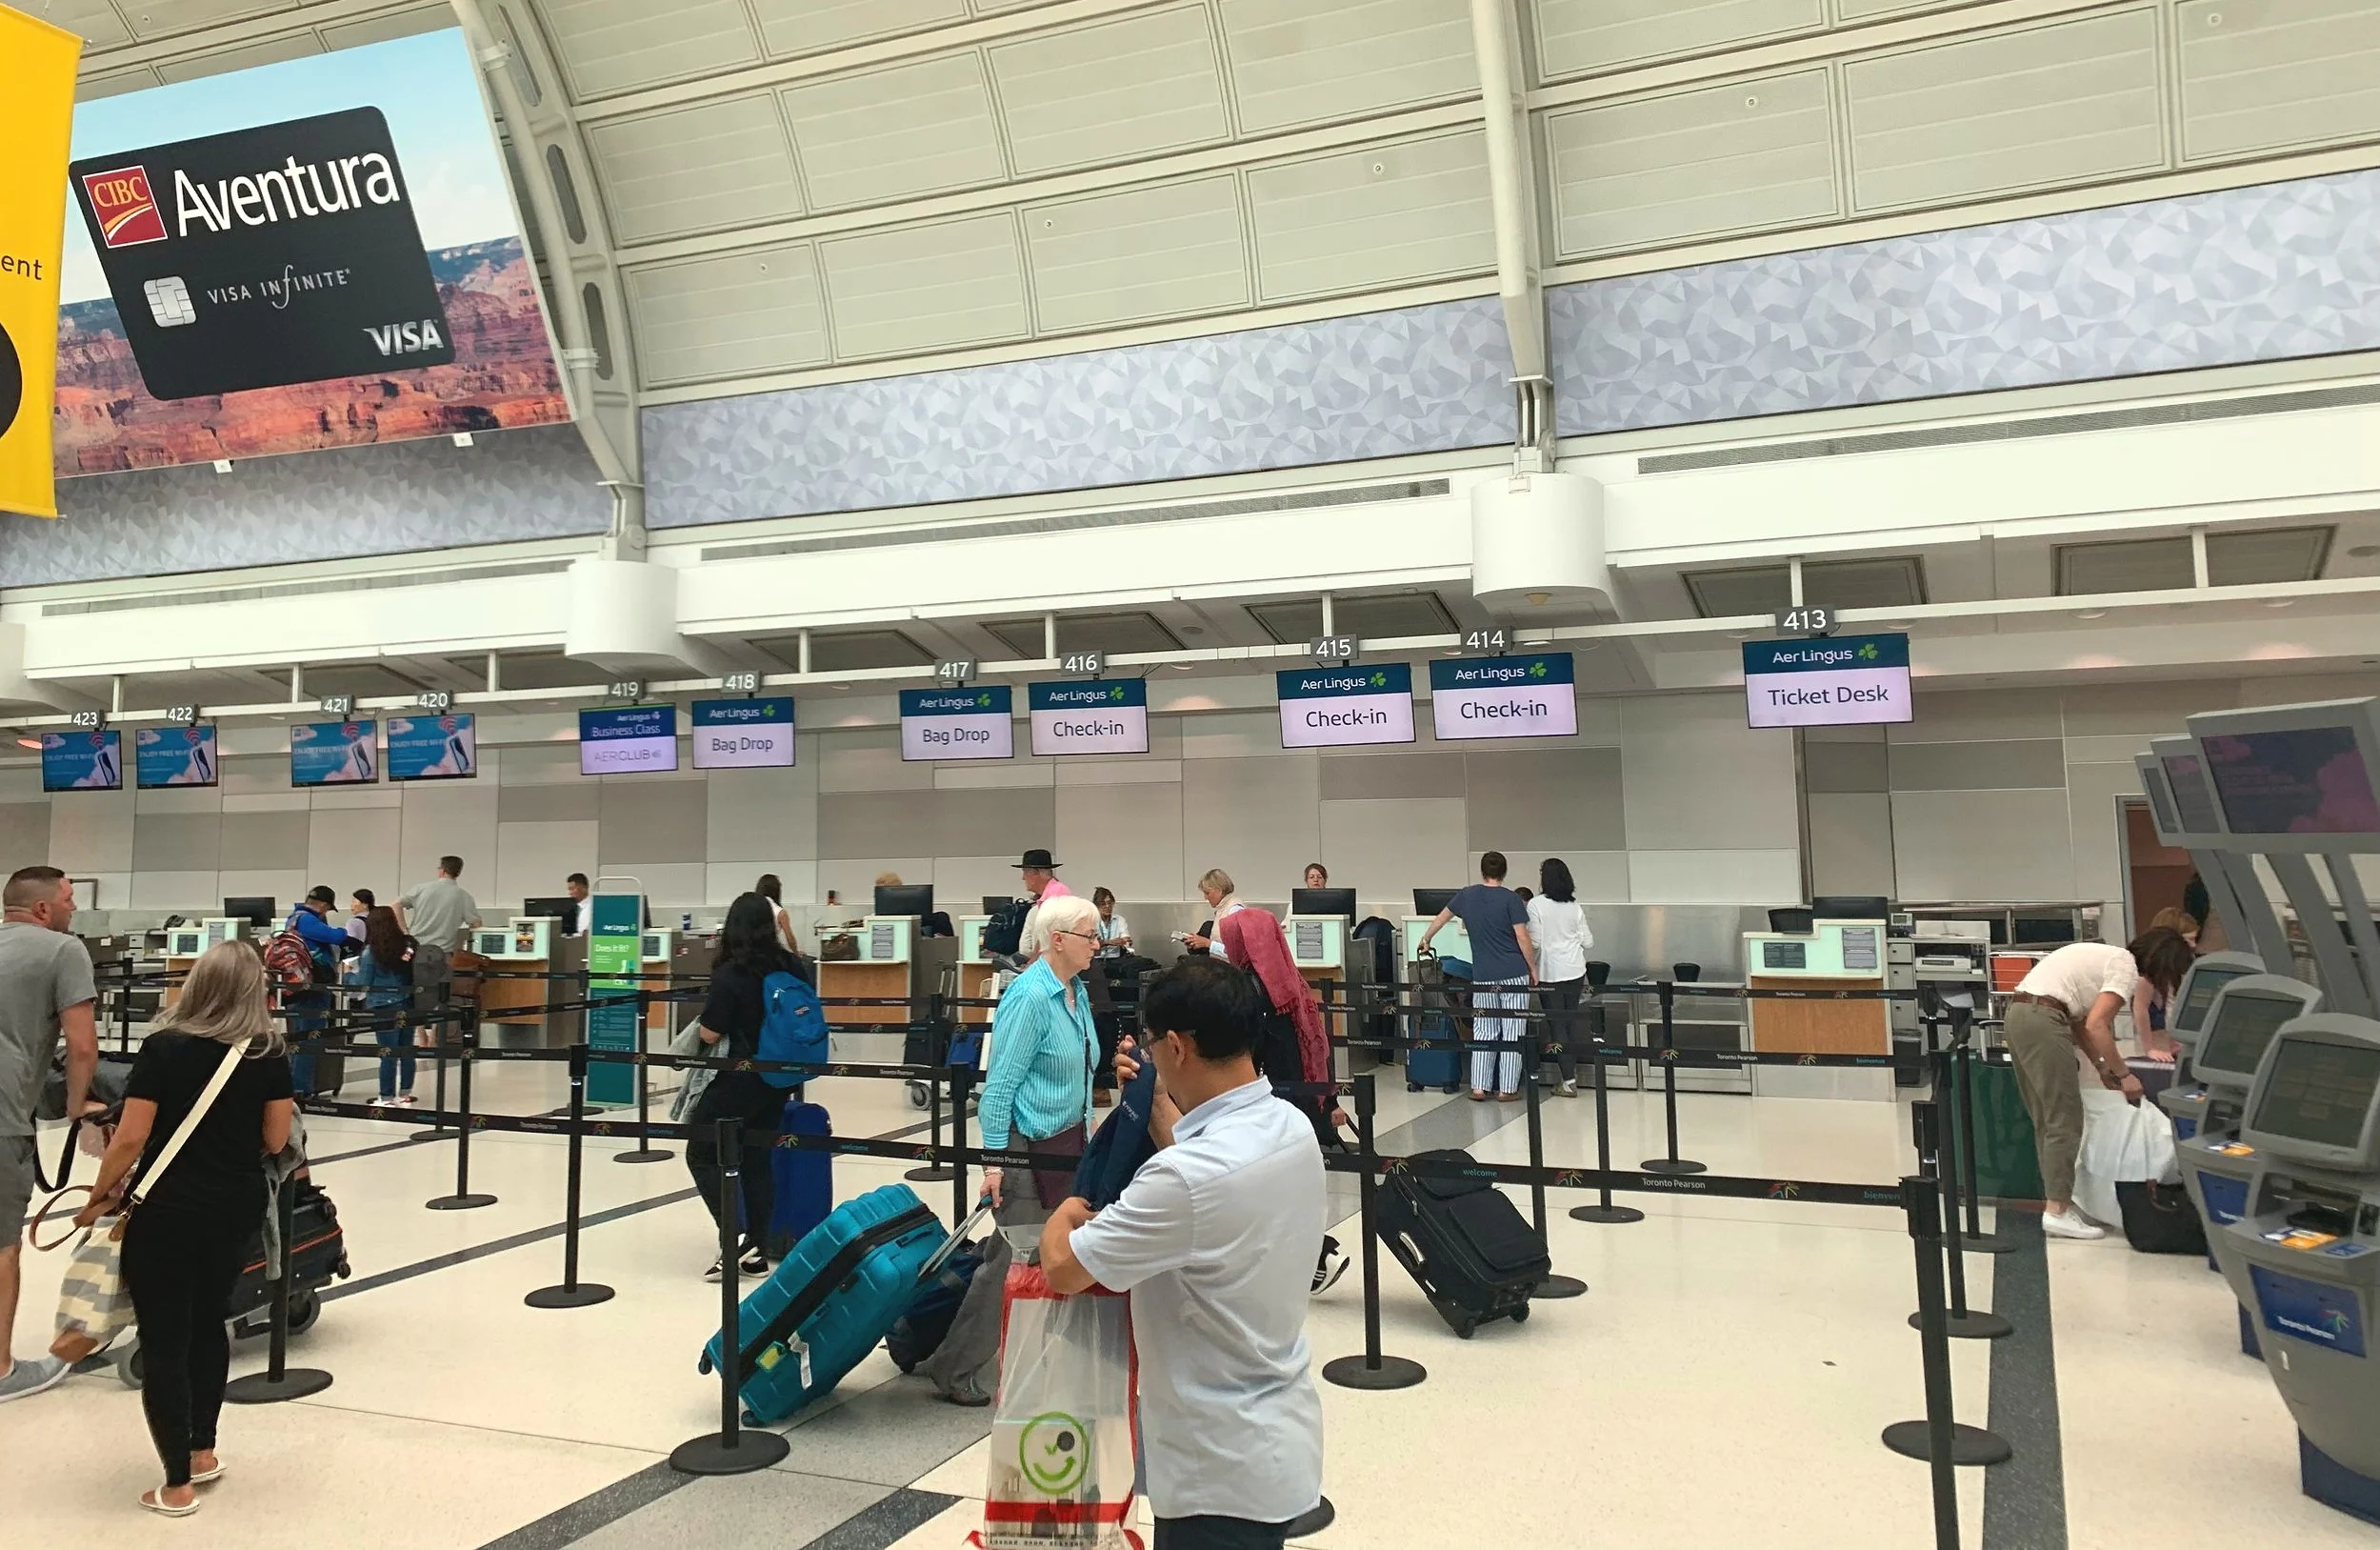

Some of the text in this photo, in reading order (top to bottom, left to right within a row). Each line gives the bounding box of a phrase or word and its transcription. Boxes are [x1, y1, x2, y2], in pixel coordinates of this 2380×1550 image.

[93, 176, 148, 208] CIBC
[173, 151, 400, 237] Aventura
[208, 286, 251, 305] VISA
[362, 318, 444, 356] VISA
[1783, 609, 1827, 631] 413
[1466, 630, 1505, 648] 414
[1315, 638, 1351, 657] 415
[1065, 654, 1097, 672] 416
[1772, 649, 1853, 665] Aer Lingus
[939, 662, 970, 678] 417
[1455, 667, 1525, 681] Aer Lingus
[611, 681, 639, 697] 419
[725, 674, 755, 691] 418
[1300, 676, 1366, 691] Aer Lingus
[419, 693, 448, 708] 420
[919, 696, 974, 710] Aer Lingus
[1049, 690, 1107, 703] Aer Lingus
[1768, 684, 1890, 706] Ticket Desk
[324, 698, 348, 713] 421
[1460, 699, 1548, 719] Check-in
[72, 712, 97, 726] 423
[168, 706, 192, 722] 422
[710, 708, 760, 720] Aer Lingus
[1306, 709, 1388, 728] Check-in
[591, 725, 661, 737] Business Class
[1053, 719, 1124, 737] Check-in
[923, 728, 990, 745] Bag Drop
[712, 737, 773, 754] Bag Drop
[980, 1154, 1030, 1165] Toronto Pearson
[1463, 1168, 1497, 1178] welcome
[1642, 1178, 1706, 1189] Toronto Pearson
